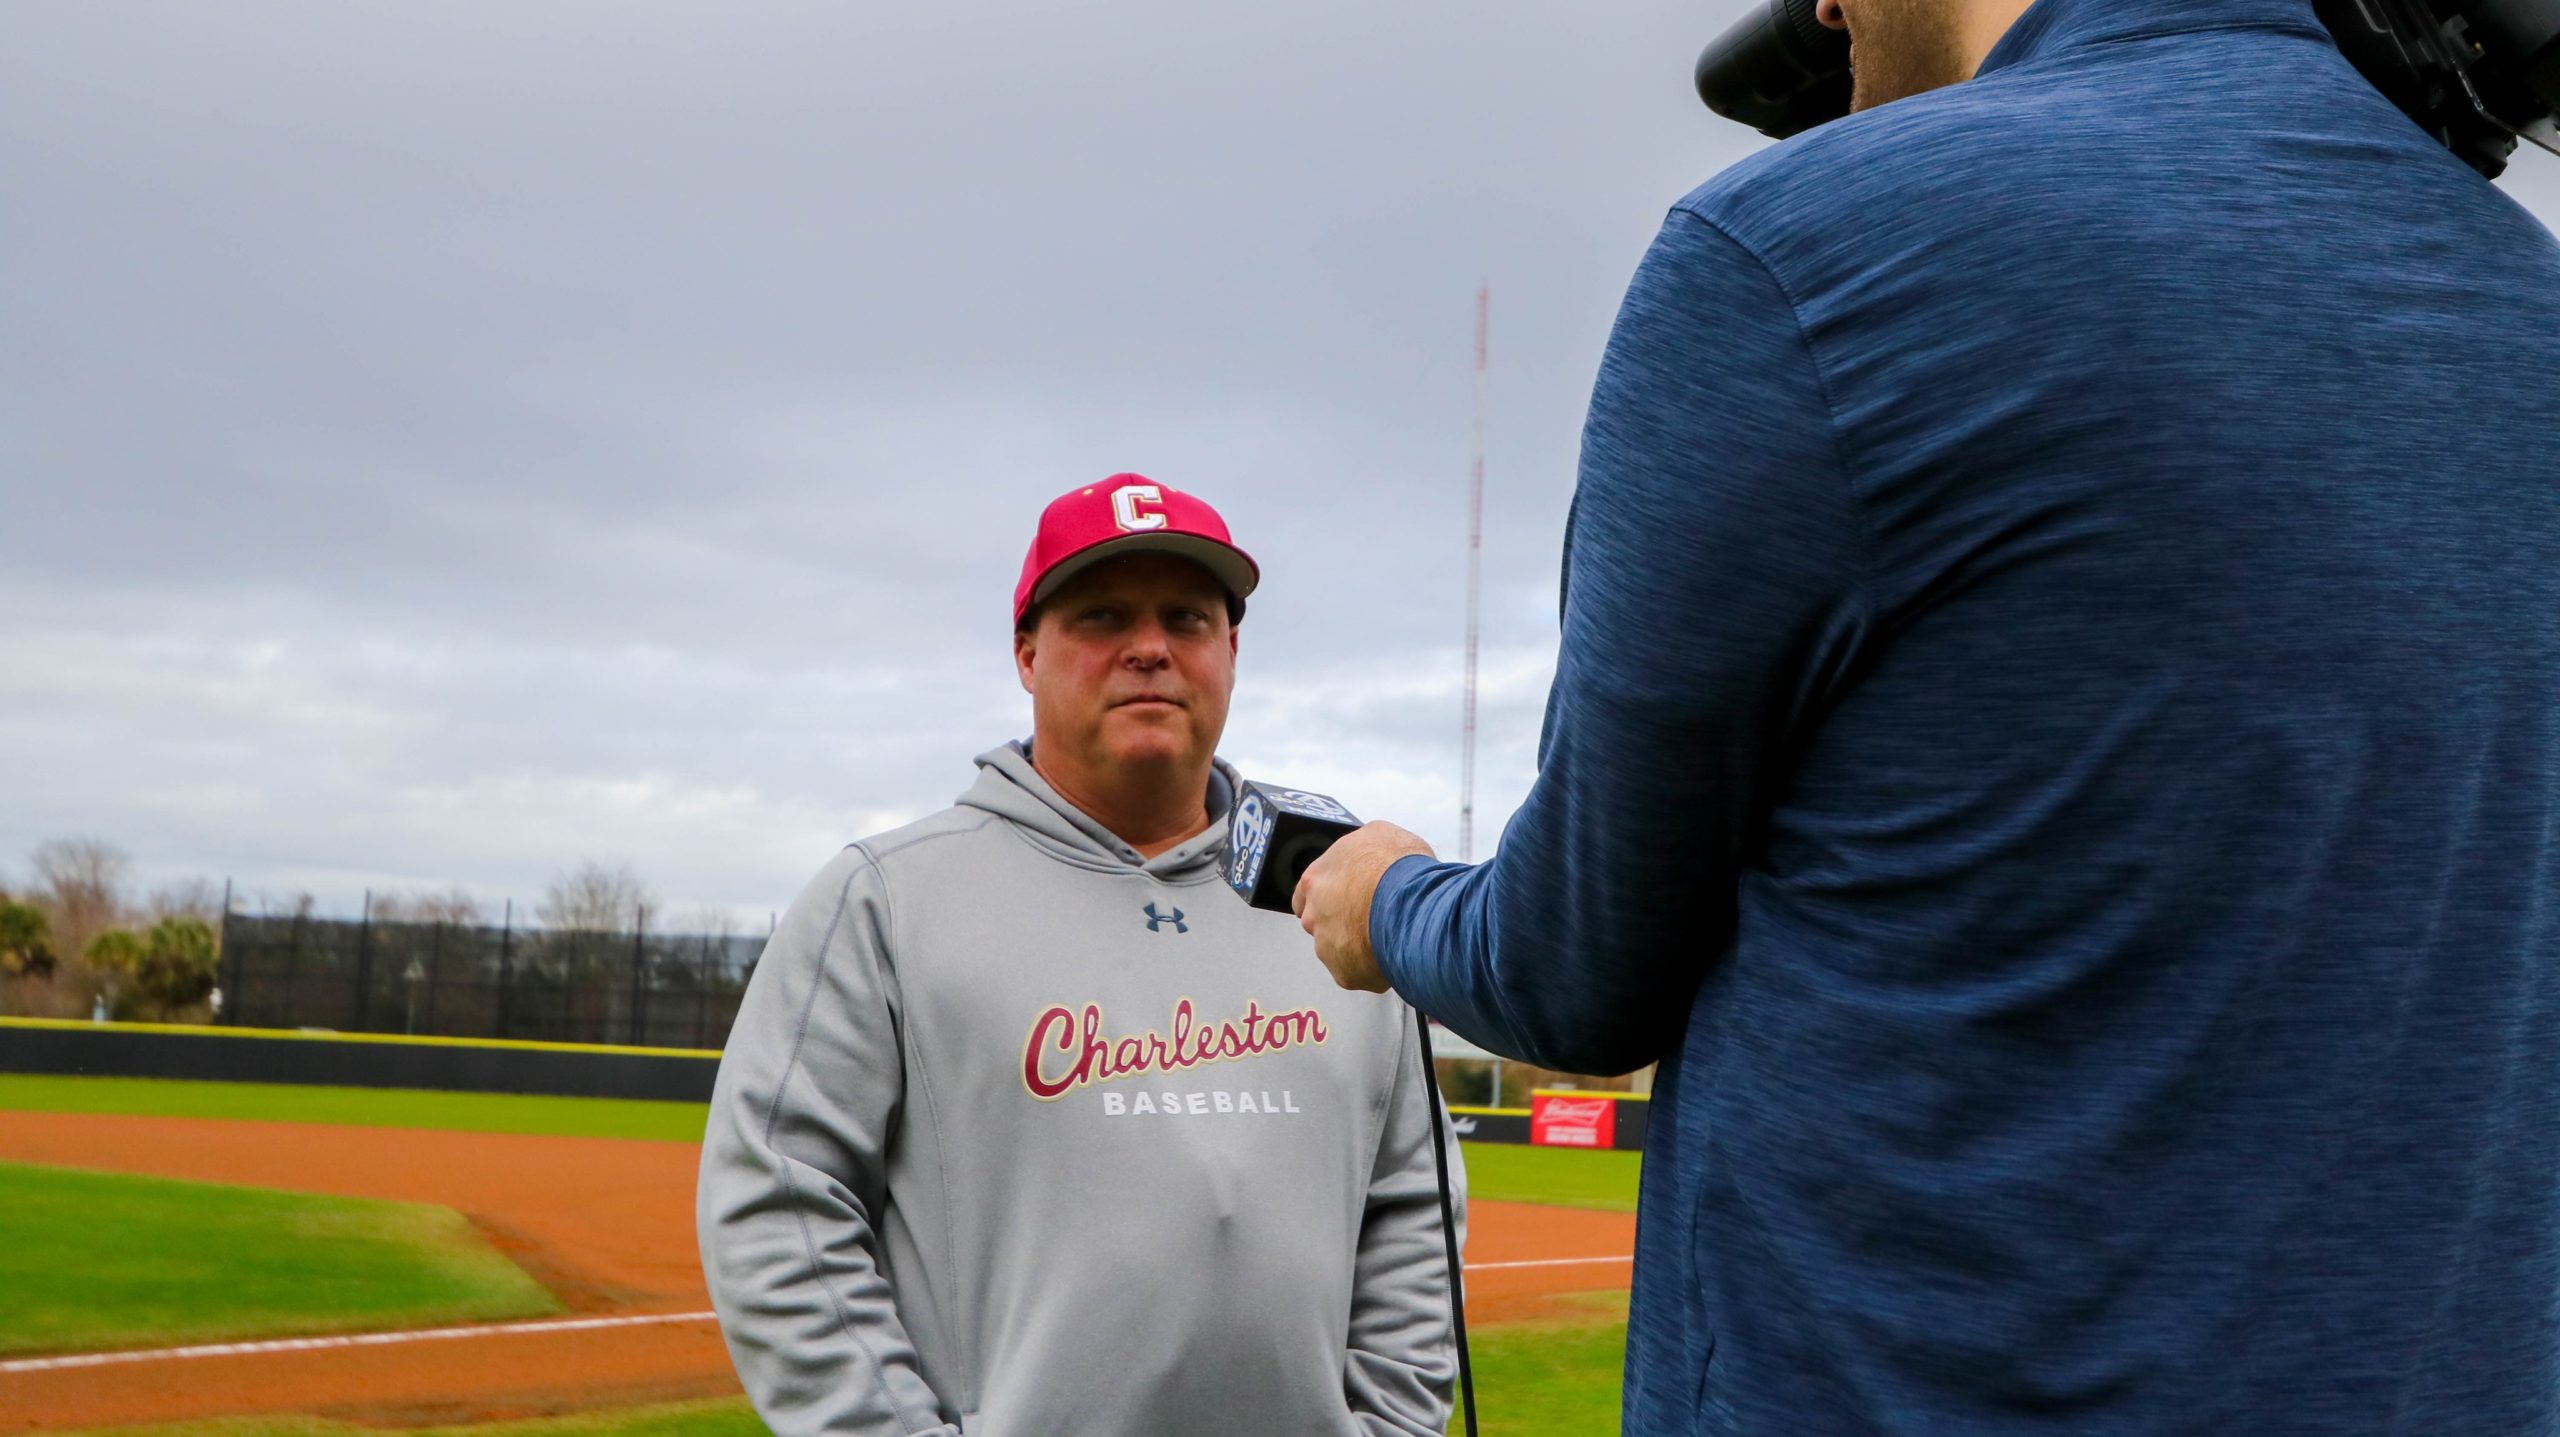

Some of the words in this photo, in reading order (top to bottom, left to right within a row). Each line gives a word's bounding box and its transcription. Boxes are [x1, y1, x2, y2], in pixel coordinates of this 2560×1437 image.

[1110, 485, 1167, 532] C
[1246, 817, 1272, 888] NEWS
[1021, 995, 1329, 1100] Charleston
[1102, 1091, 1300, 1116] BASEBALL
